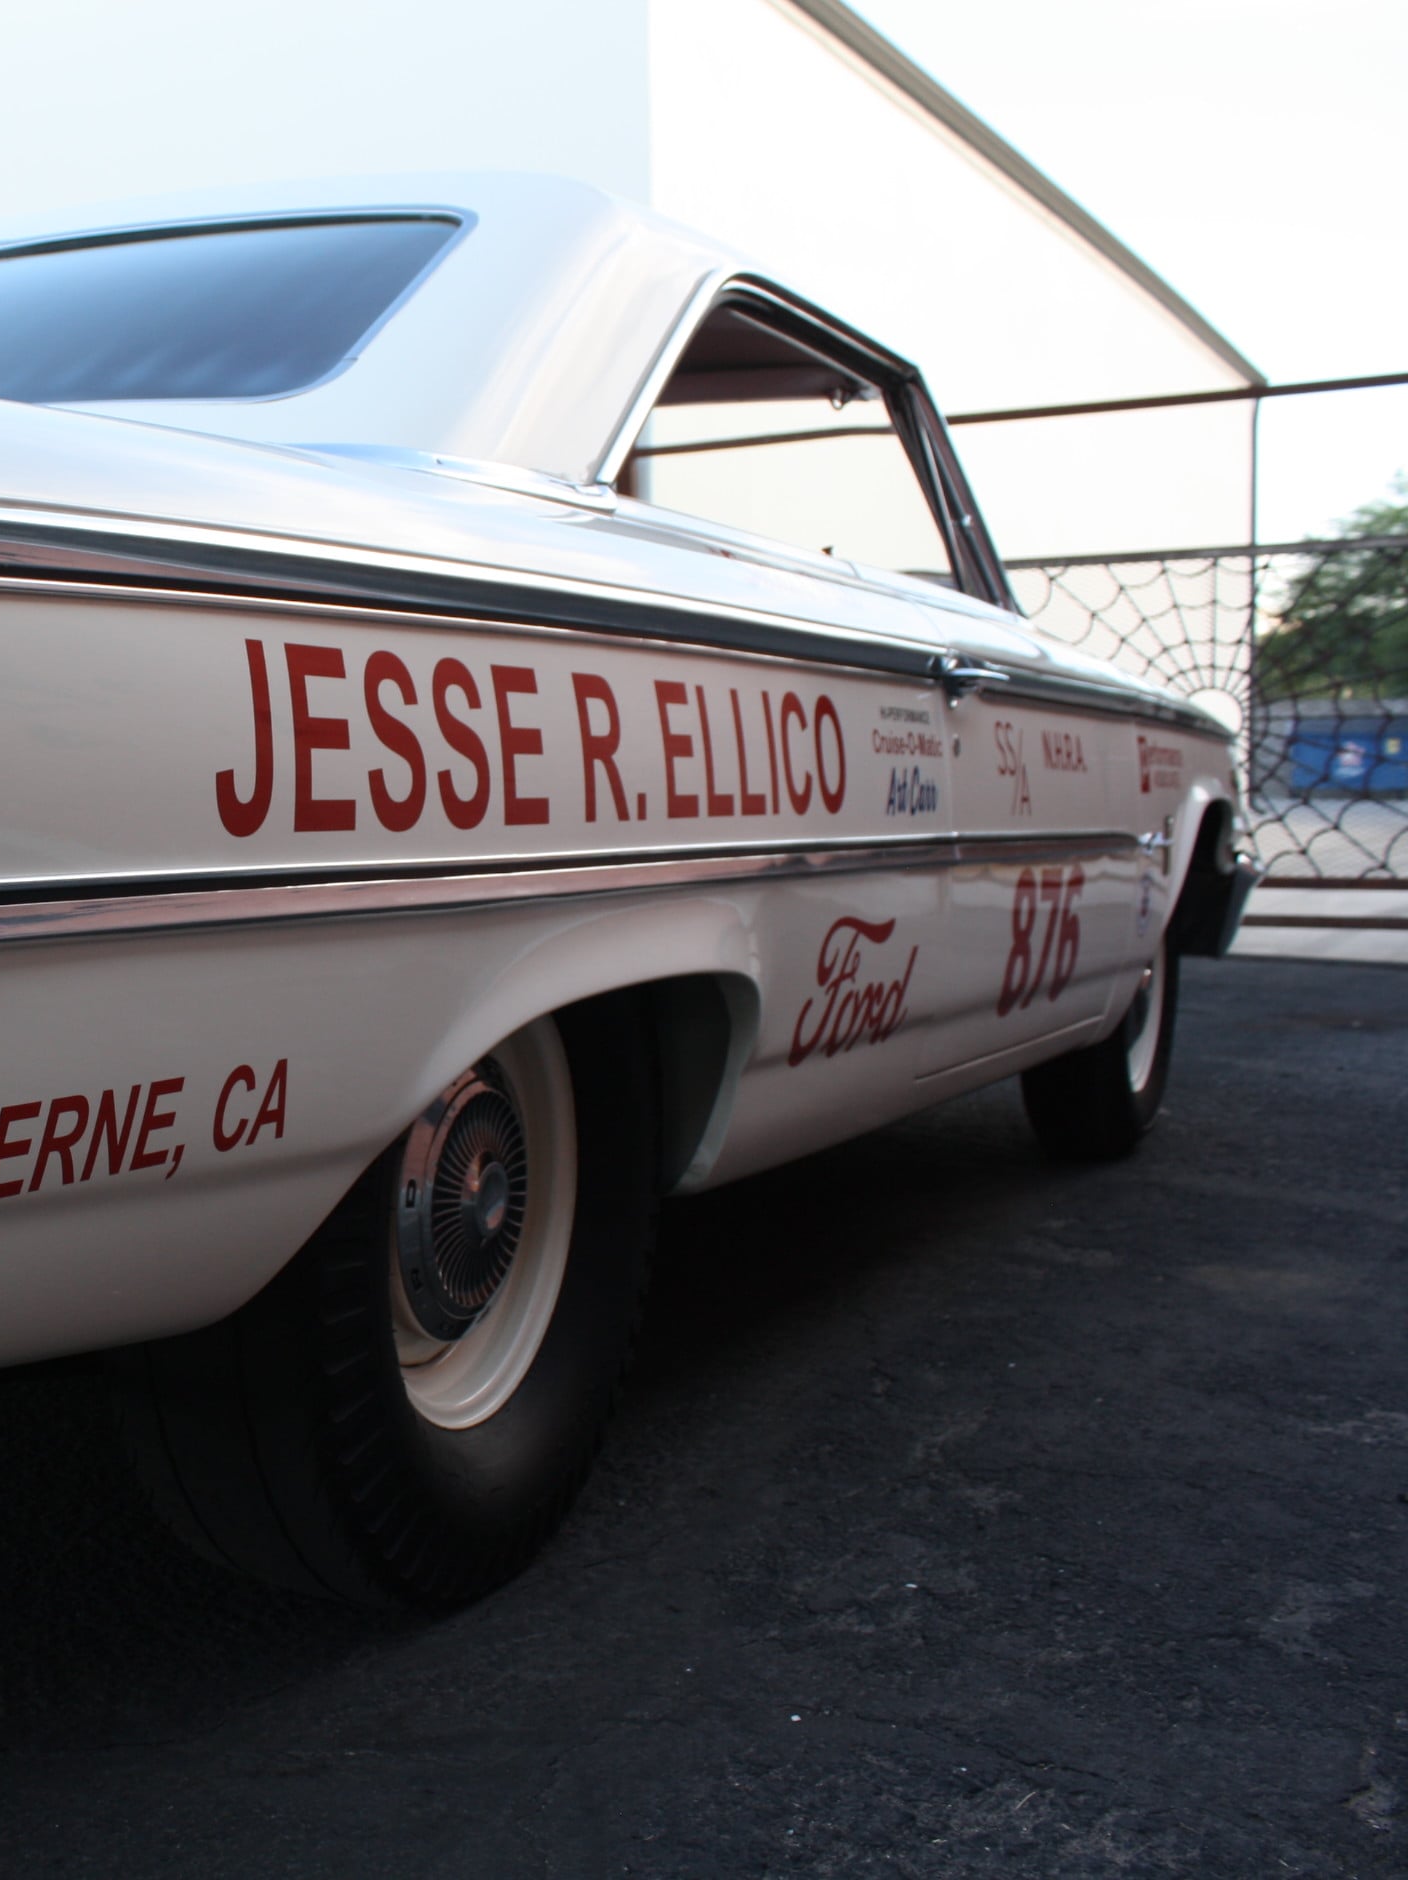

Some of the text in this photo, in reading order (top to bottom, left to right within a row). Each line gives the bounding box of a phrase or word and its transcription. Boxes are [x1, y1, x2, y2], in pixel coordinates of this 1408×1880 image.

[215, 638, 846, 838] JESSE R. ELLICO
[788, 915, 920, 1068] Ford
[996, 861, 1086, 1018] 876
[212, 1058, 289, 1153] CA
